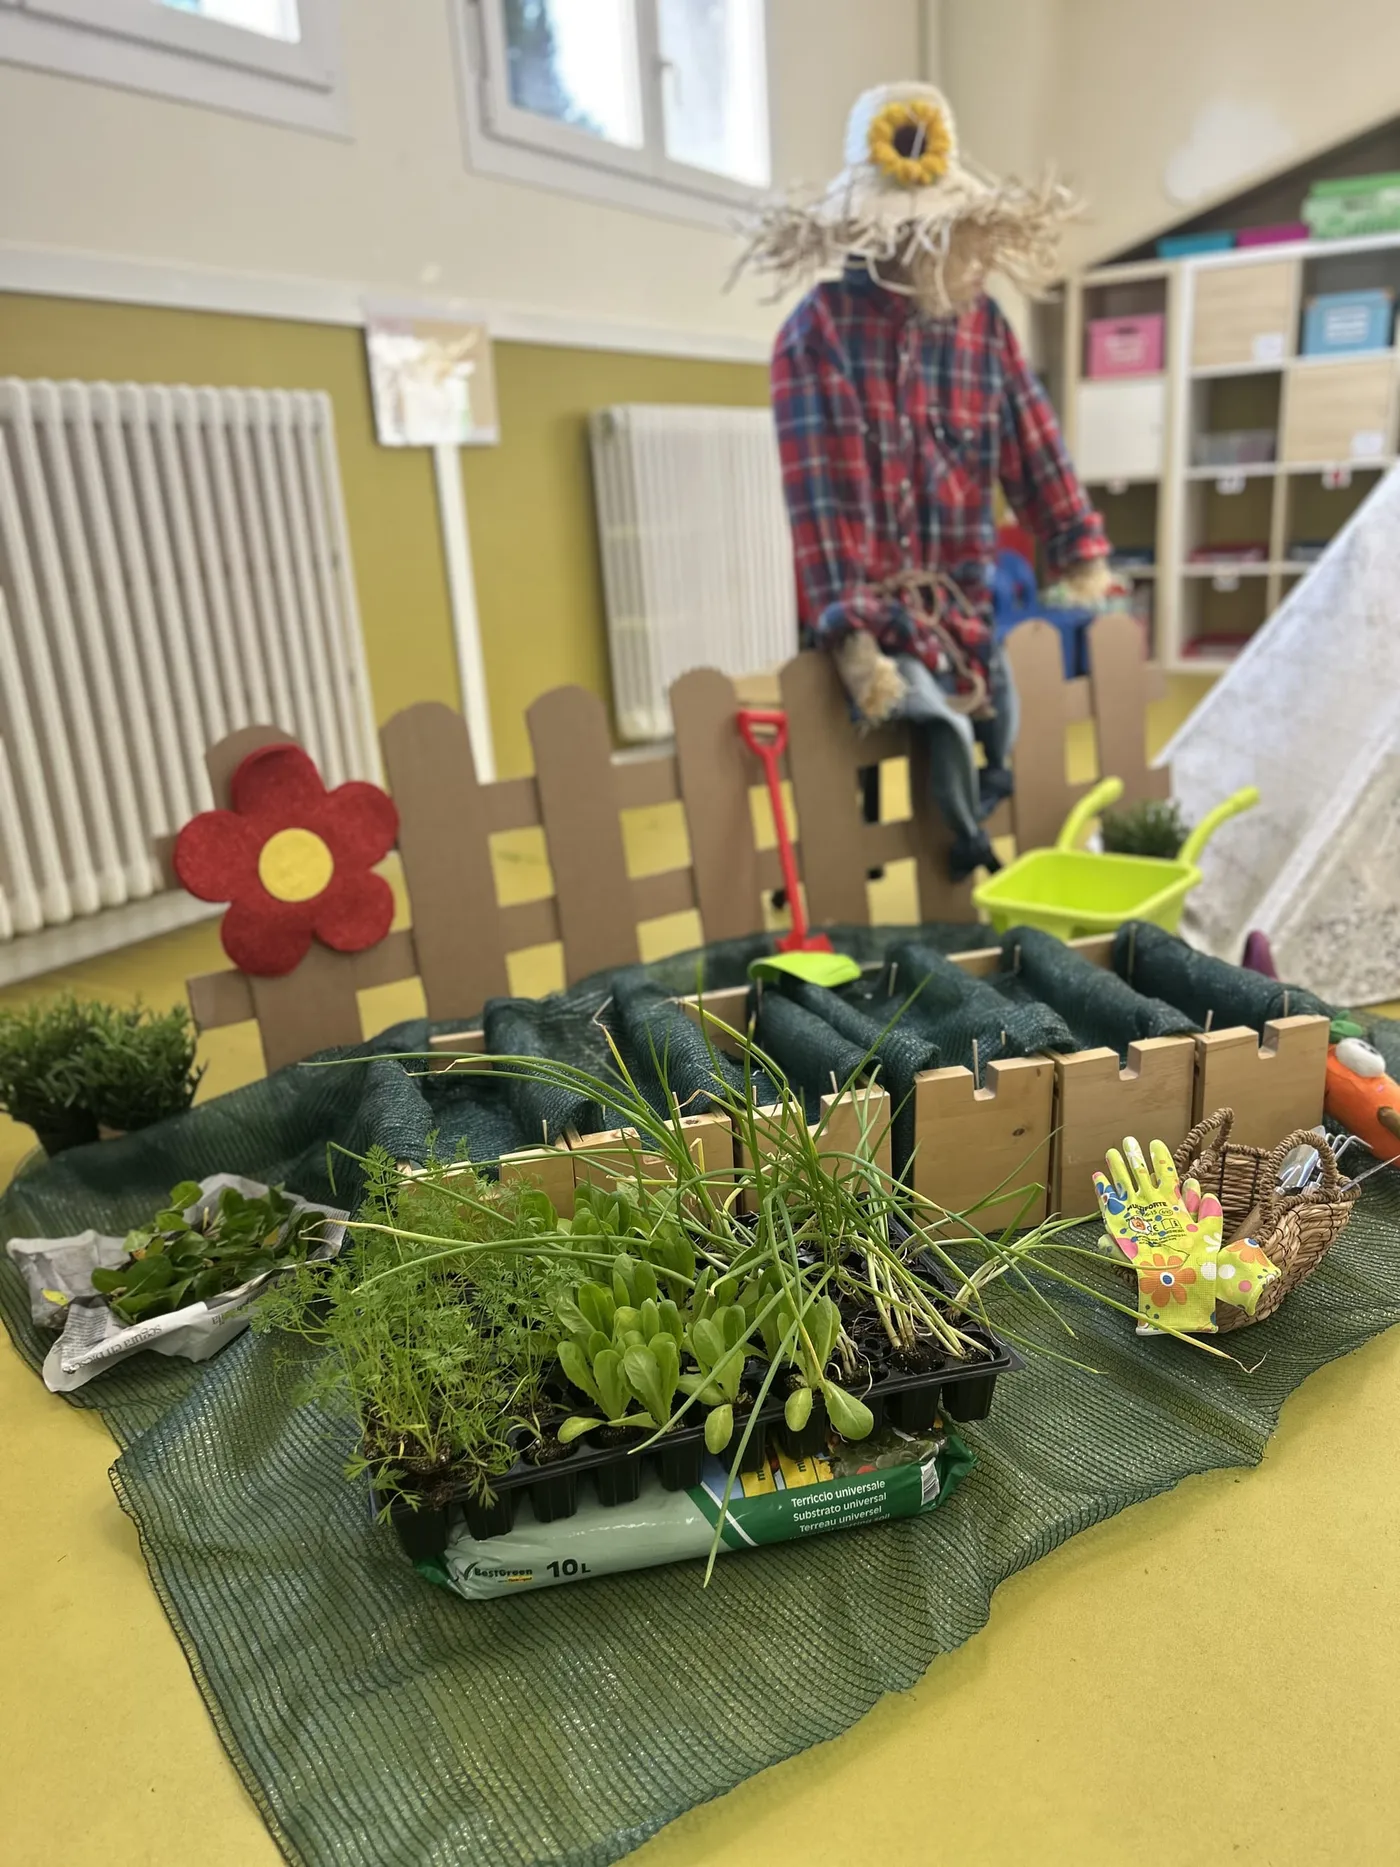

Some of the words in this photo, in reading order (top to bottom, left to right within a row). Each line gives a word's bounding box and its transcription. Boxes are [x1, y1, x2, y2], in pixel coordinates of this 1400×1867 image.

[791, 1491, 834, 1508] Terriccio
[835, 1480, 886, 1499] universale
[793, 1504, 841, 1522] Substrato
[843, 1492, 887, 1511] universal
[800, 1518, 837, 1533] Terreau
[839, 1505, 882, 1523] universel
[546, 1558, 578, 1578] 10
[581, 1563, 591, 1574] L
